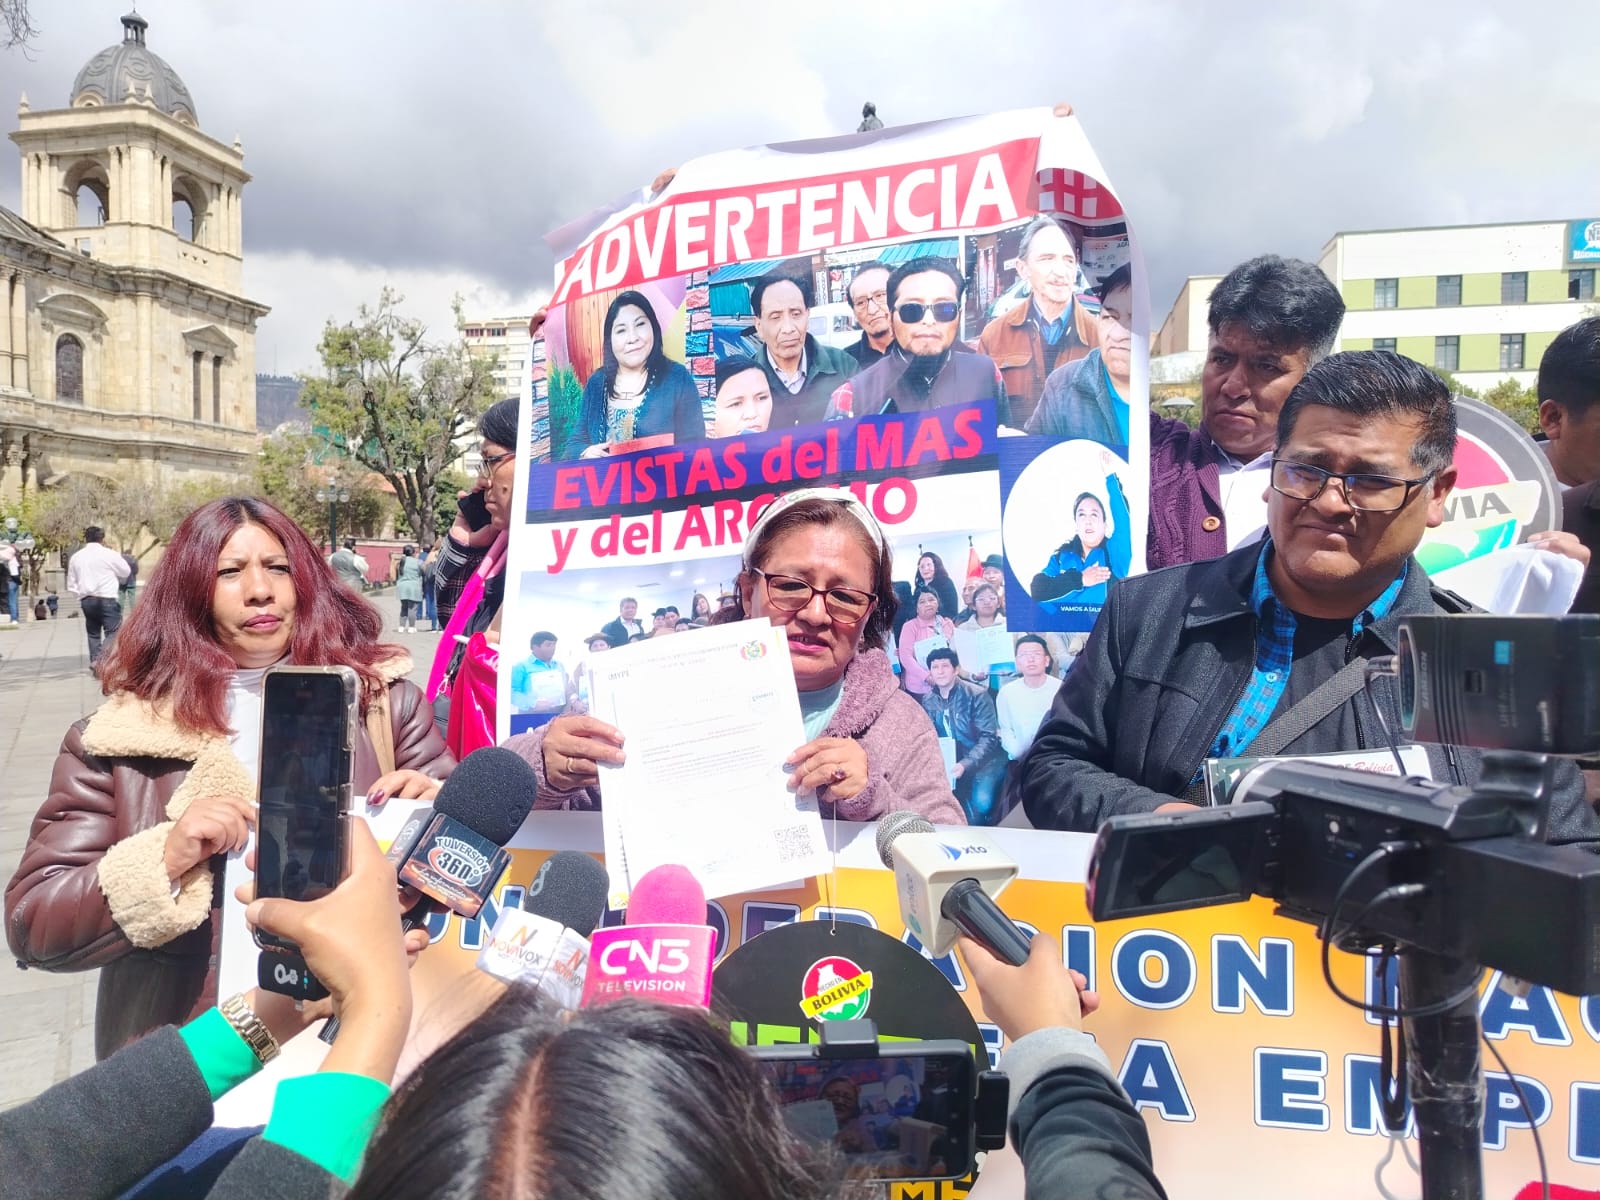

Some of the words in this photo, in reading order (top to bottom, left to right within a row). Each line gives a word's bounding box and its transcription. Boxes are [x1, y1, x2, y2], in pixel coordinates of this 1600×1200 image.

[556, 153, 1018, 304] ADVERTENCIA
[553, 441, 747, 510] EVISTAS
[762, 422, 838, 484] del
[855, 409, 982, 471] MAS
[547, 527, 579, 574] y
[590, 510, 662, 558] del
[489, 937, 543, 966] NOVAVOX
[600, 938, 690, 975] CN3
[597, 979, 686, 994] TELEVISION
[812, 978, 866, 1010] BOLIVIA
